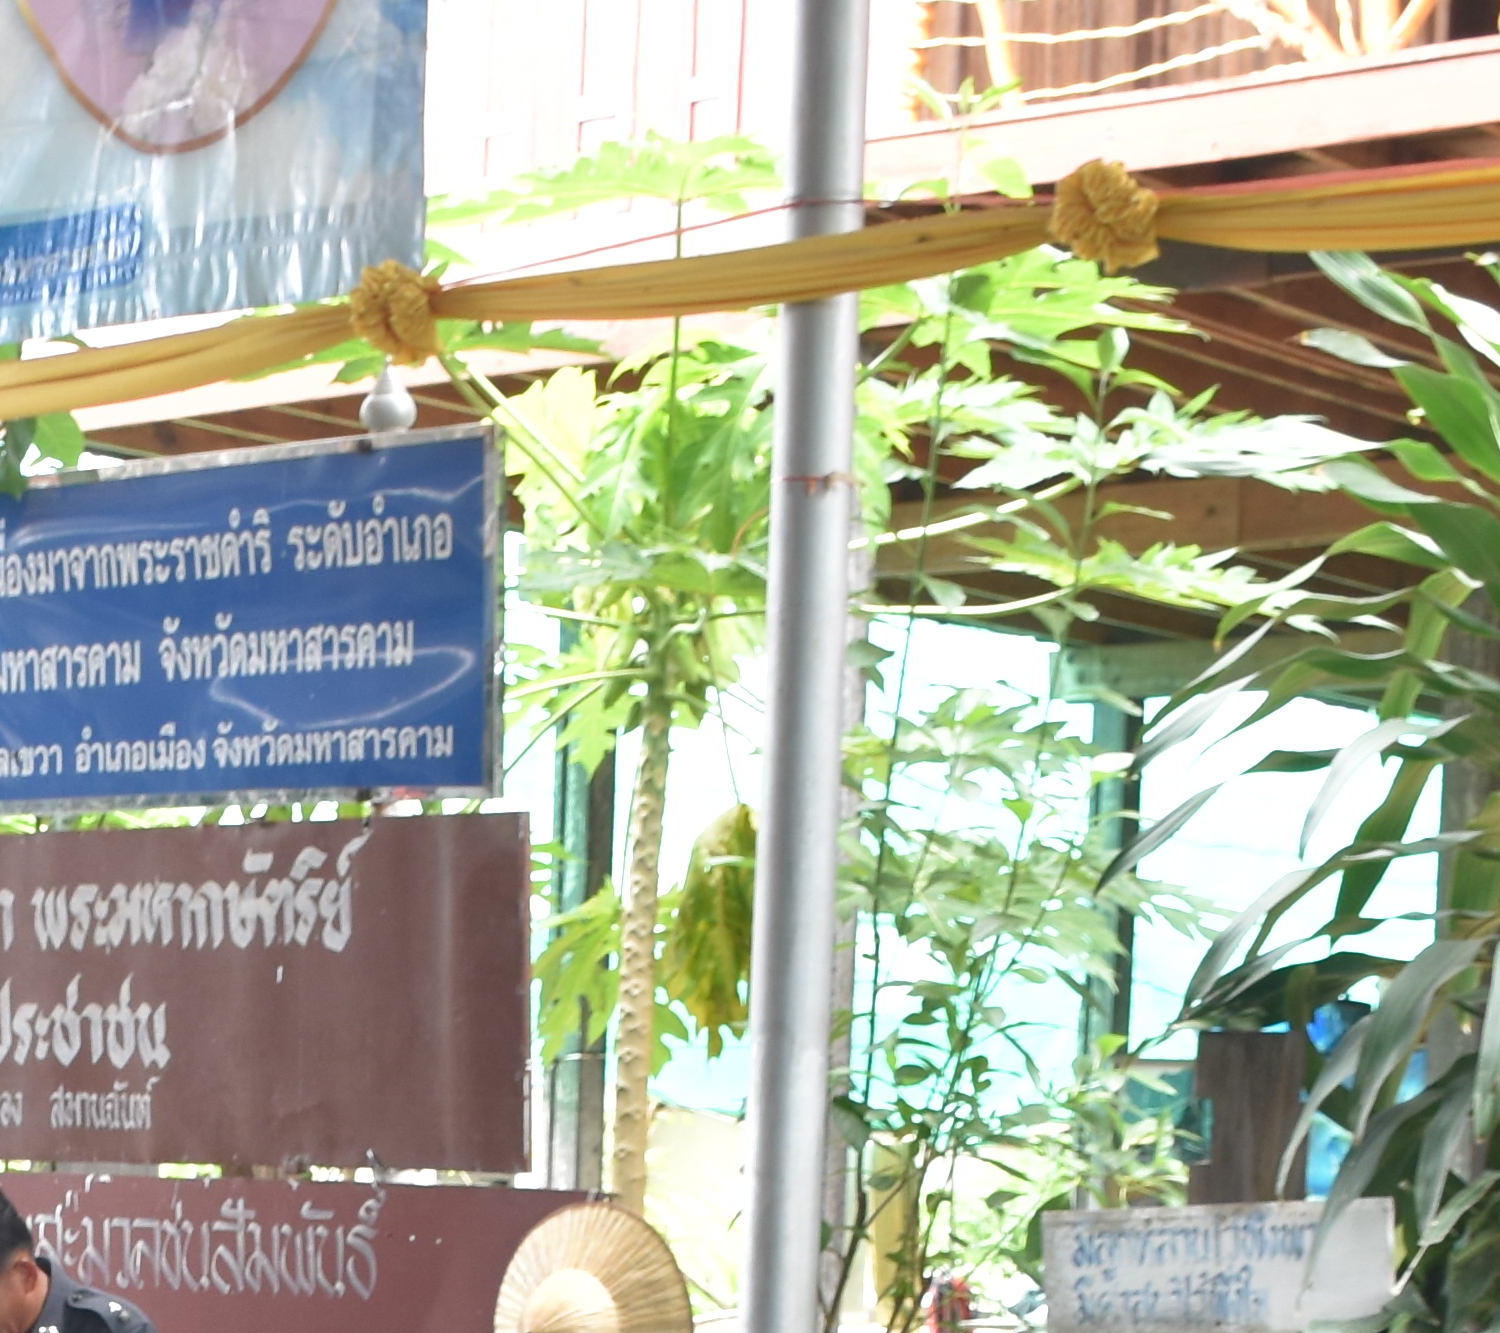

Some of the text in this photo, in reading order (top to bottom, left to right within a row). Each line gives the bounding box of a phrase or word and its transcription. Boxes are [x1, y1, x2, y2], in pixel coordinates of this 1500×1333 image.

[288, 493, 454, 572] ระดับอำเภอ
[158, 612, 414, 682] จังหวัดมหาสารคาม
[75, 721, 206, 773] อำเภอเมือง
[212, 718, 454, 769] จังหวัดมหาสารคาม
[31, 830, 373, 953] พระมหากษัตริย์
[50, 1075, 162, 1131] สมานฉันท์
